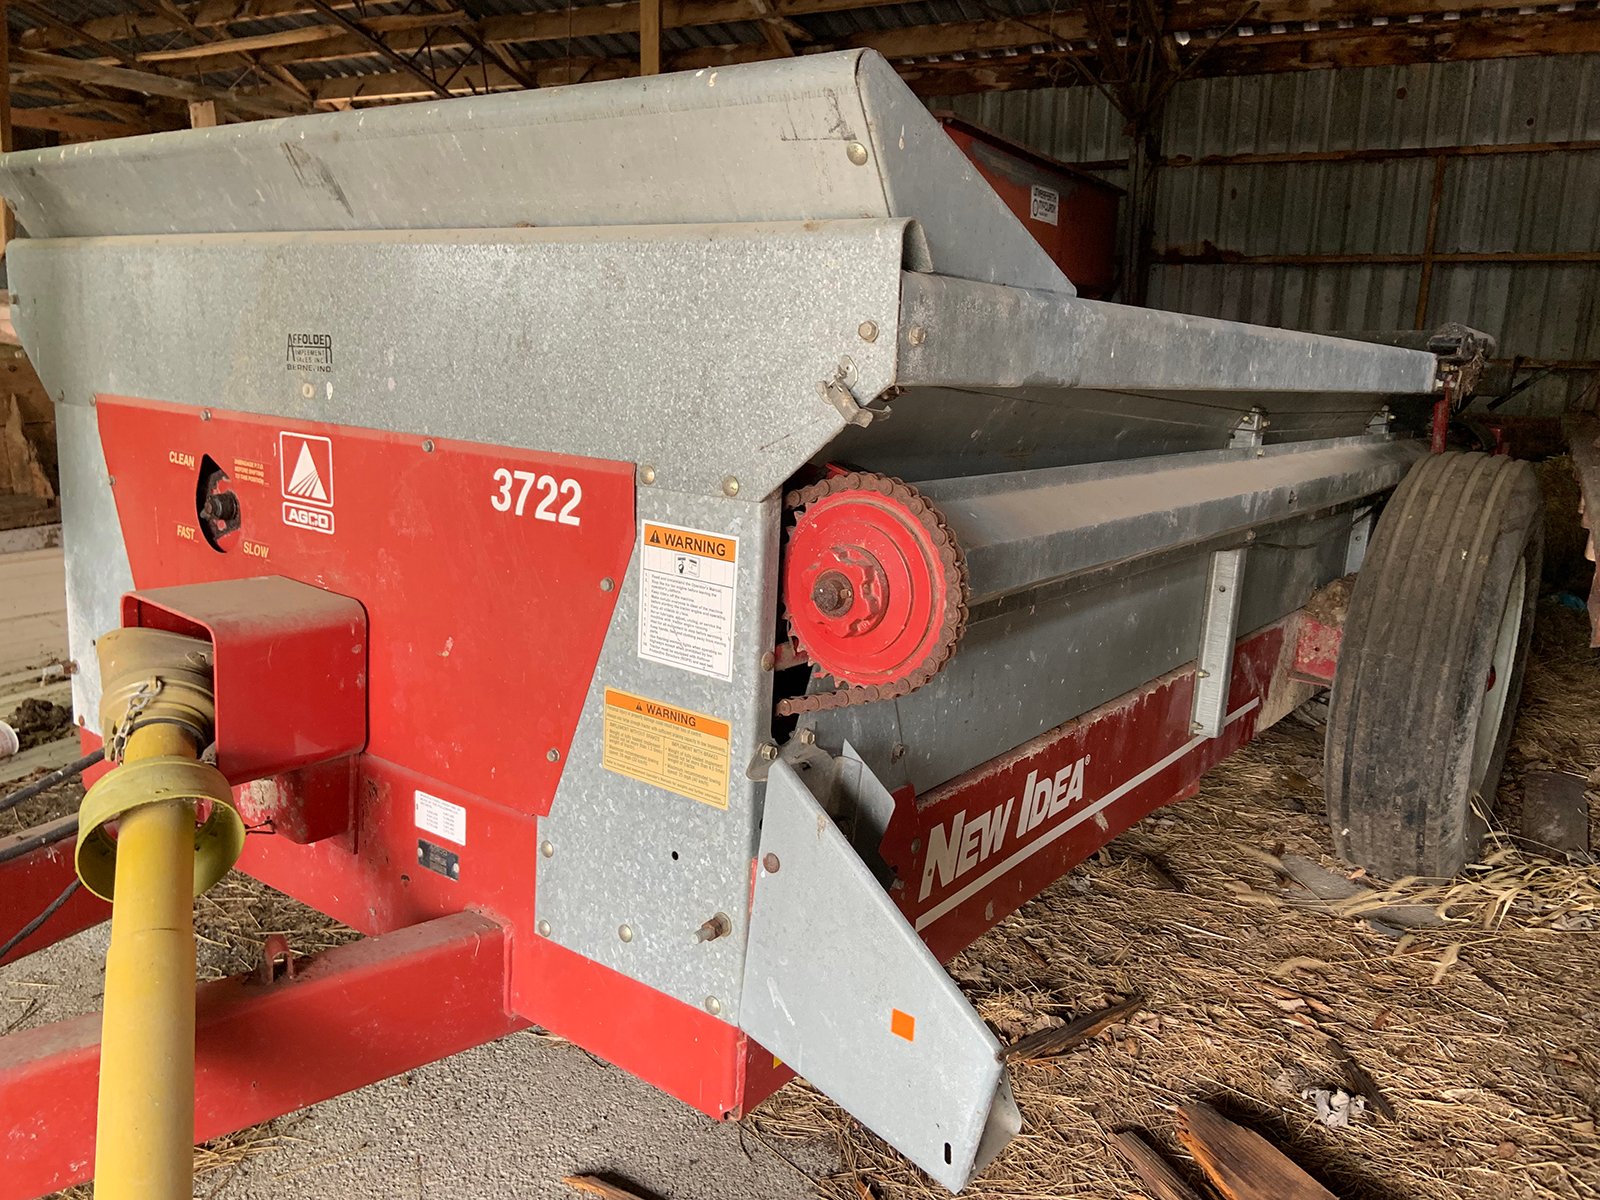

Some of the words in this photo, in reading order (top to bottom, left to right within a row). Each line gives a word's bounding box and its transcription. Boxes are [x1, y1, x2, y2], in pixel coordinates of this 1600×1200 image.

[286, 333, 333, 363] AFFOLDER
[169, 450, 195, 468] CLEAN
[490, 468, 582, 526] 3722
[288, 508, 329, 528] AGCO
[176, 525, 195, 540] FAST
[243, 541, 270, 558] SLOW
[664, 533, 726, 557] WARNING
[646, 703, 696, 727] WARNING
[918, 796, 1015, 903] NEW
[1016, 757, 1085, 838] IDEA
